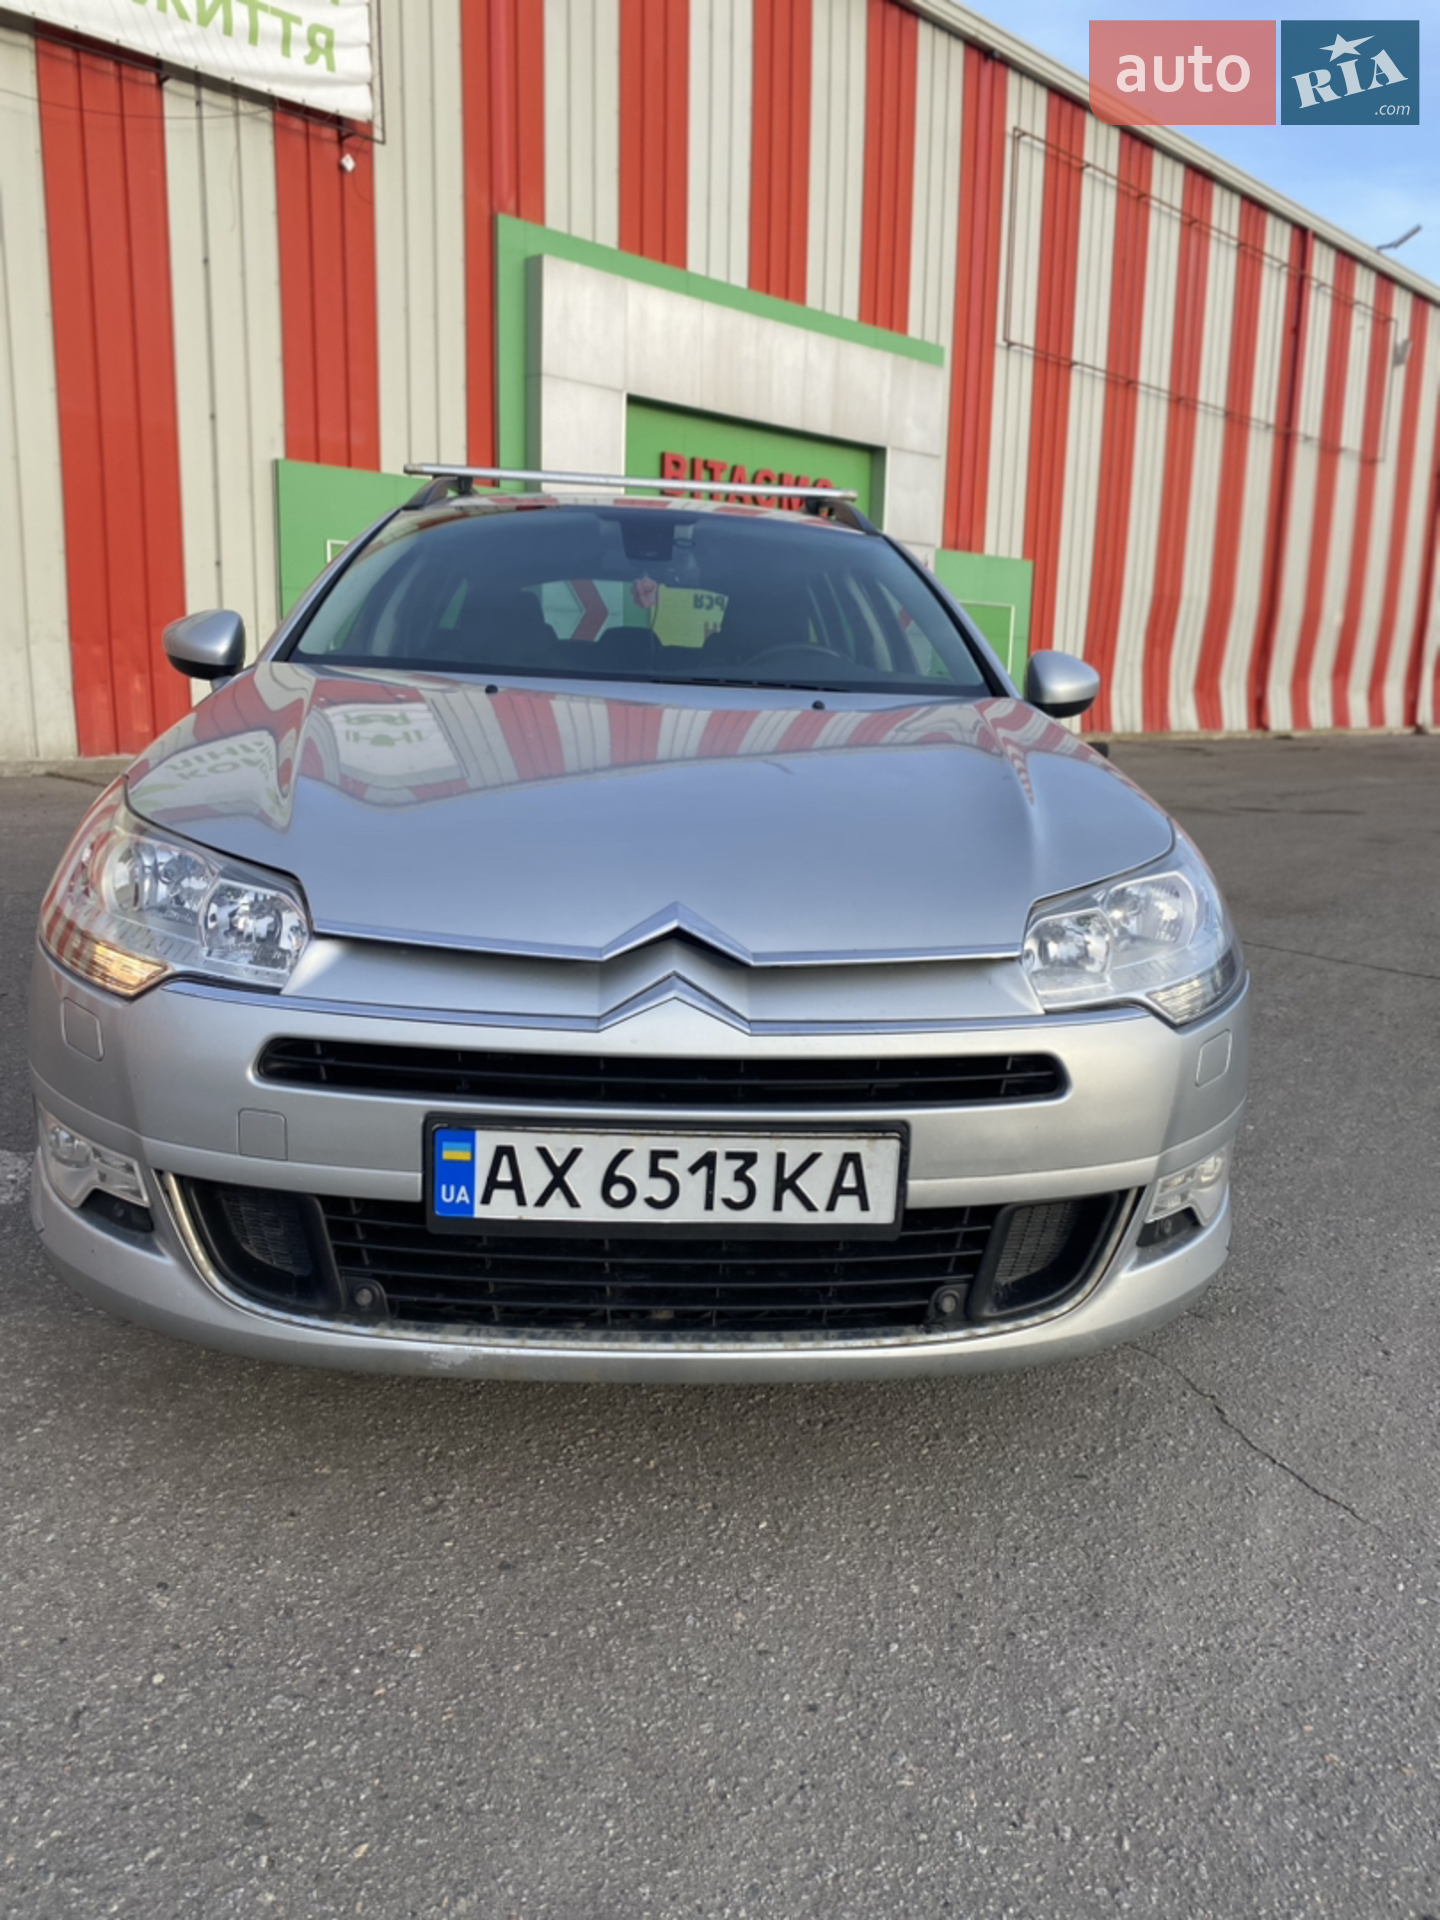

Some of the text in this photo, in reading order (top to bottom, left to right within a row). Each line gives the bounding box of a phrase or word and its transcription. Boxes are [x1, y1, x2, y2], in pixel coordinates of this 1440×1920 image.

[441, 1183, 470, 1205] UA
[480, 1144, 871, 1212] AX 6513 KA
